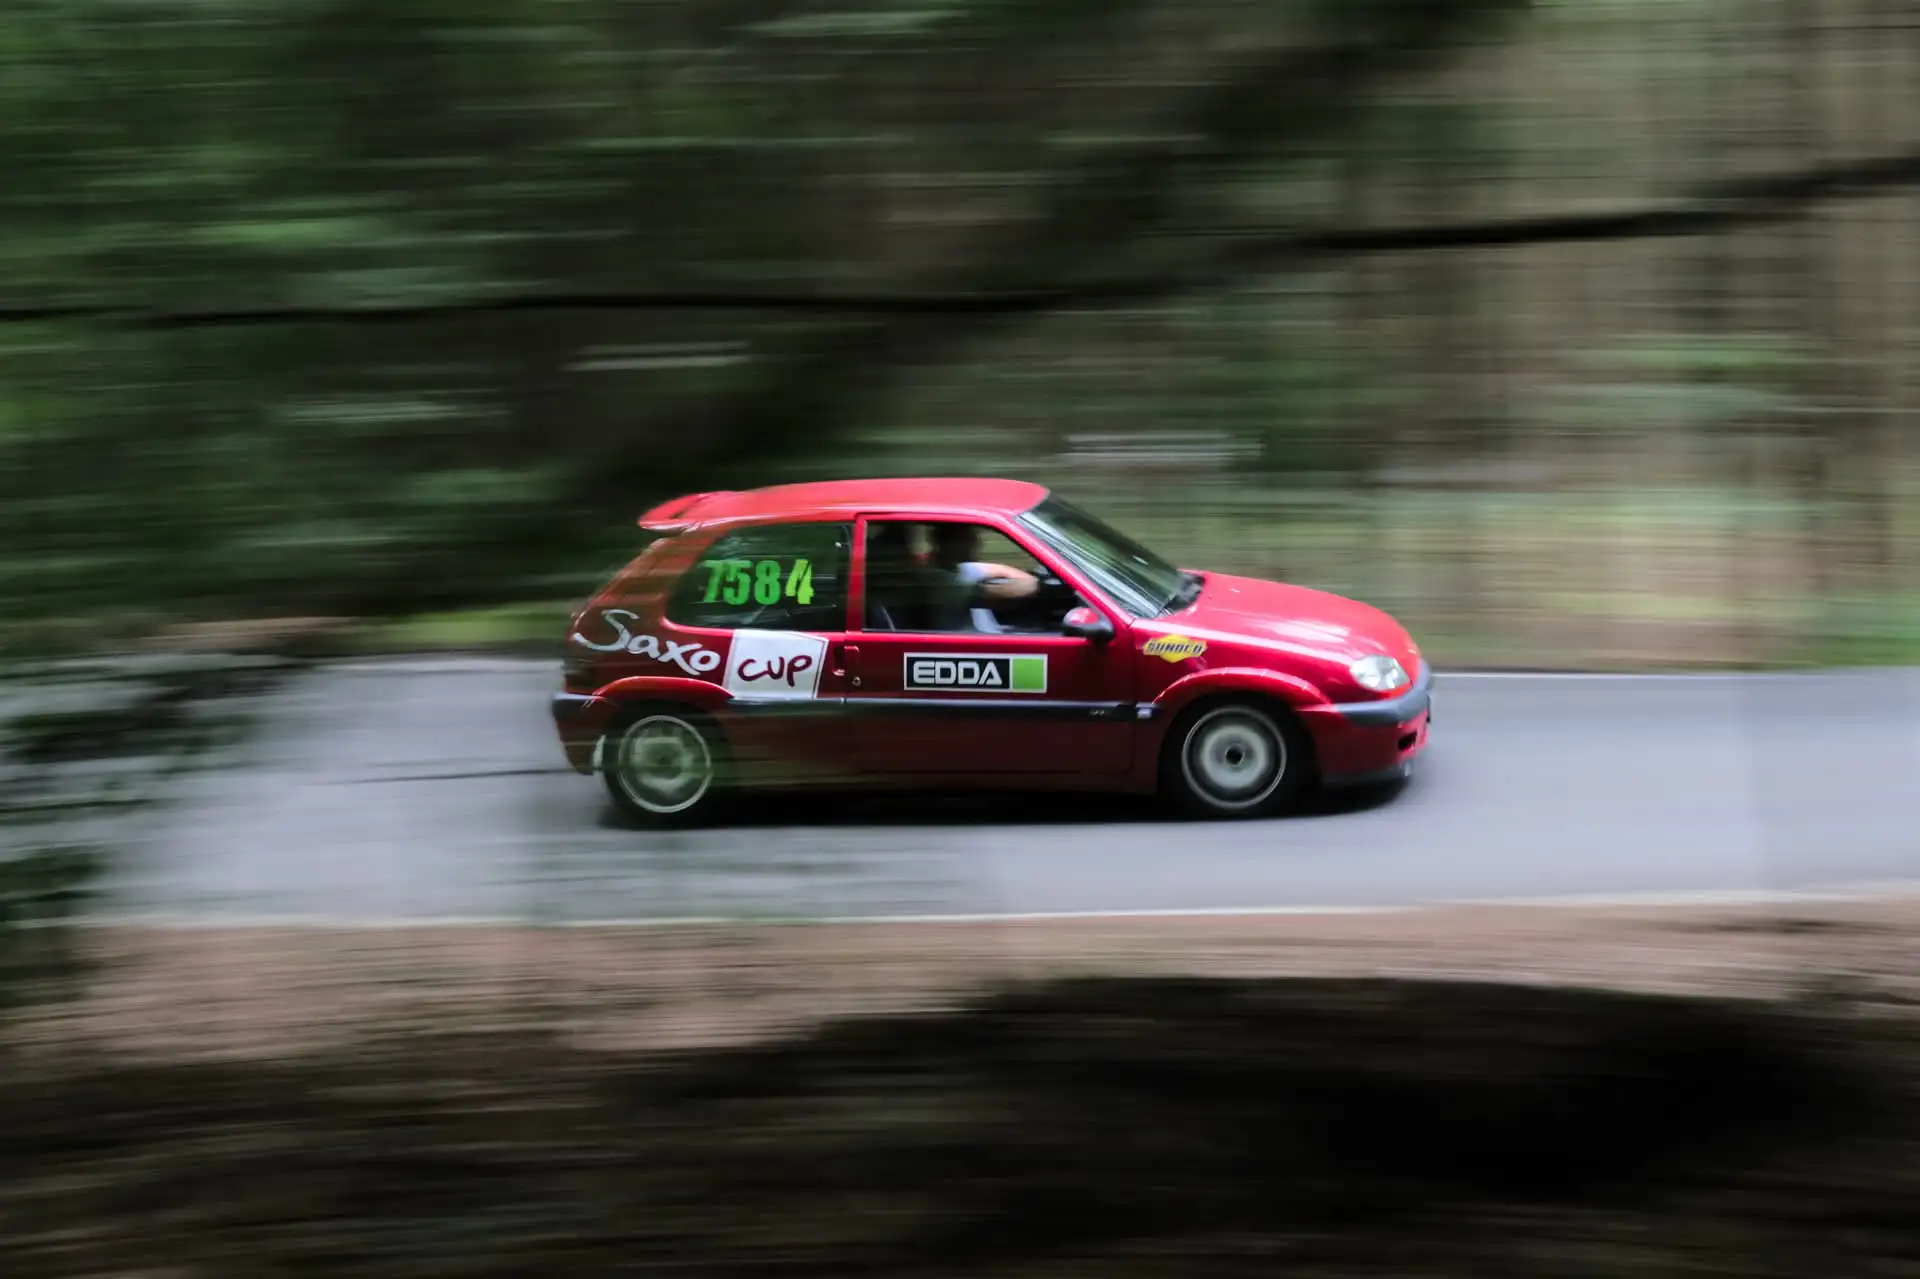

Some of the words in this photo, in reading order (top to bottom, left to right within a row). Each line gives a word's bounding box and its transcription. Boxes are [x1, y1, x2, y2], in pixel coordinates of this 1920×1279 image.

[701, 559, 815, 605] 7584
[573, 608, 721, 676] Saxo
[913, 660, 1003, 686] EDDA
